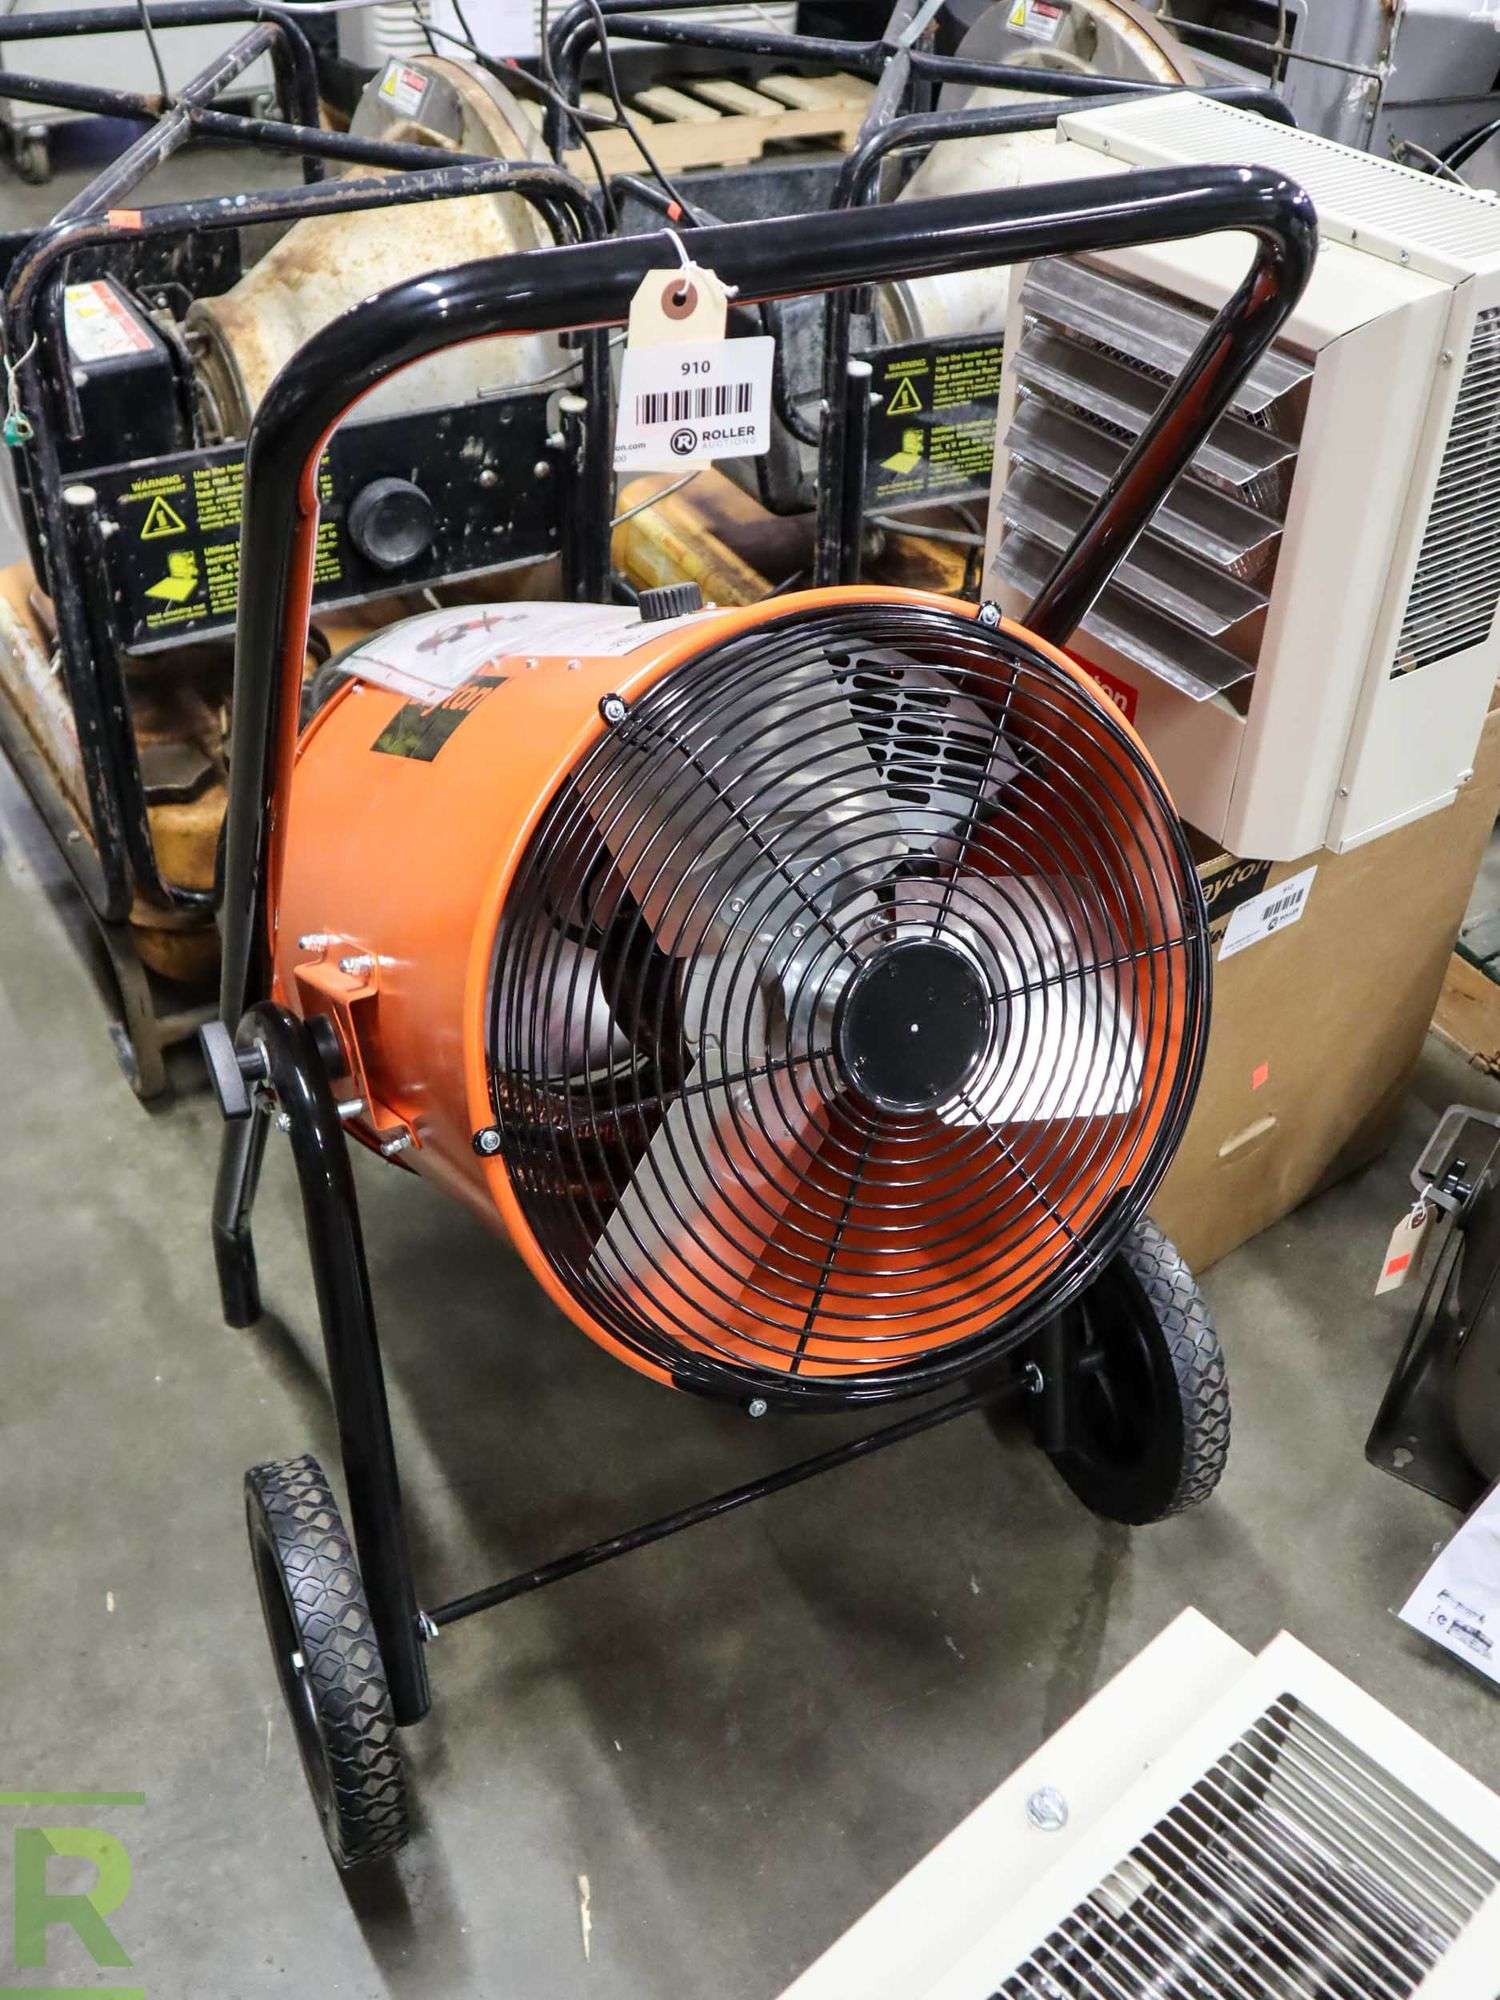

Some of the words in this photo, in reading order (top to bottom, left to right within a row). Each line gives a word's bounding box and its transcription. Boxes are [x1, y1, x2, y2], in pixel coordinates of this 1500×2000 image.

[681, 360, 711, 375] 910
[702, 426, 756, 441] ROLLER
[131, 474, 183, 491] WARNING
